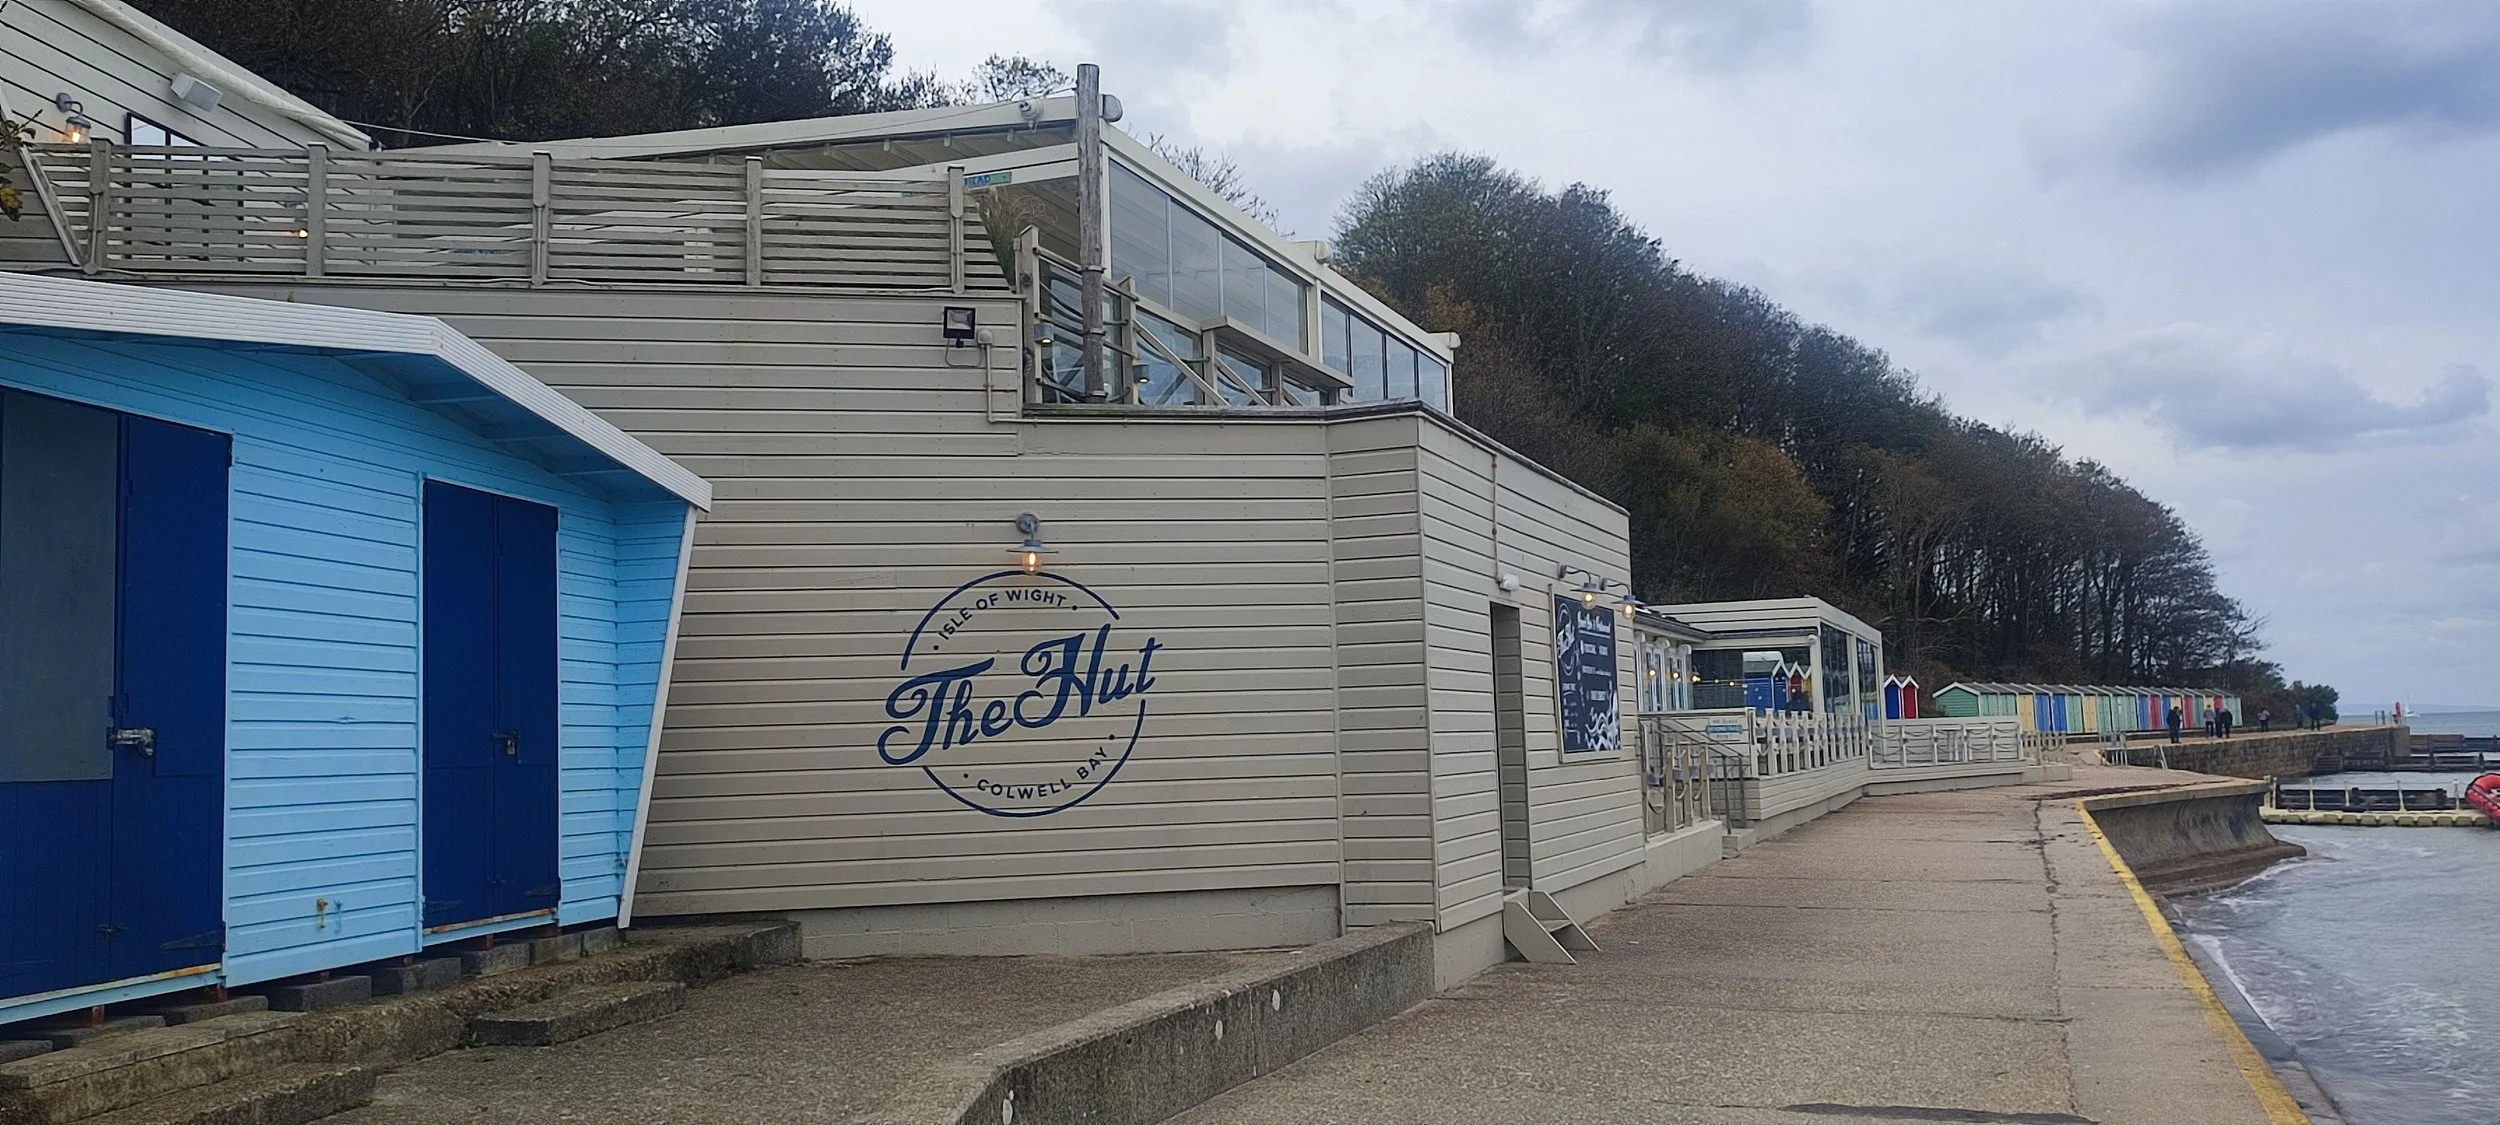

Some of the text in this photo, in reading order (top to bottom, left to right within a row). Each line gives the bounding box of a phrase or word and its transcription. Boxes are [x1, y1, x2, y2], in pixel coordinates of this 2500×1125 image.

[938, 589, 1067, 641] ISLE OF WIGHT
[877, 623, 1163, 765] The Hut
[976, 746, 1107, 800] COLWELL BAY
